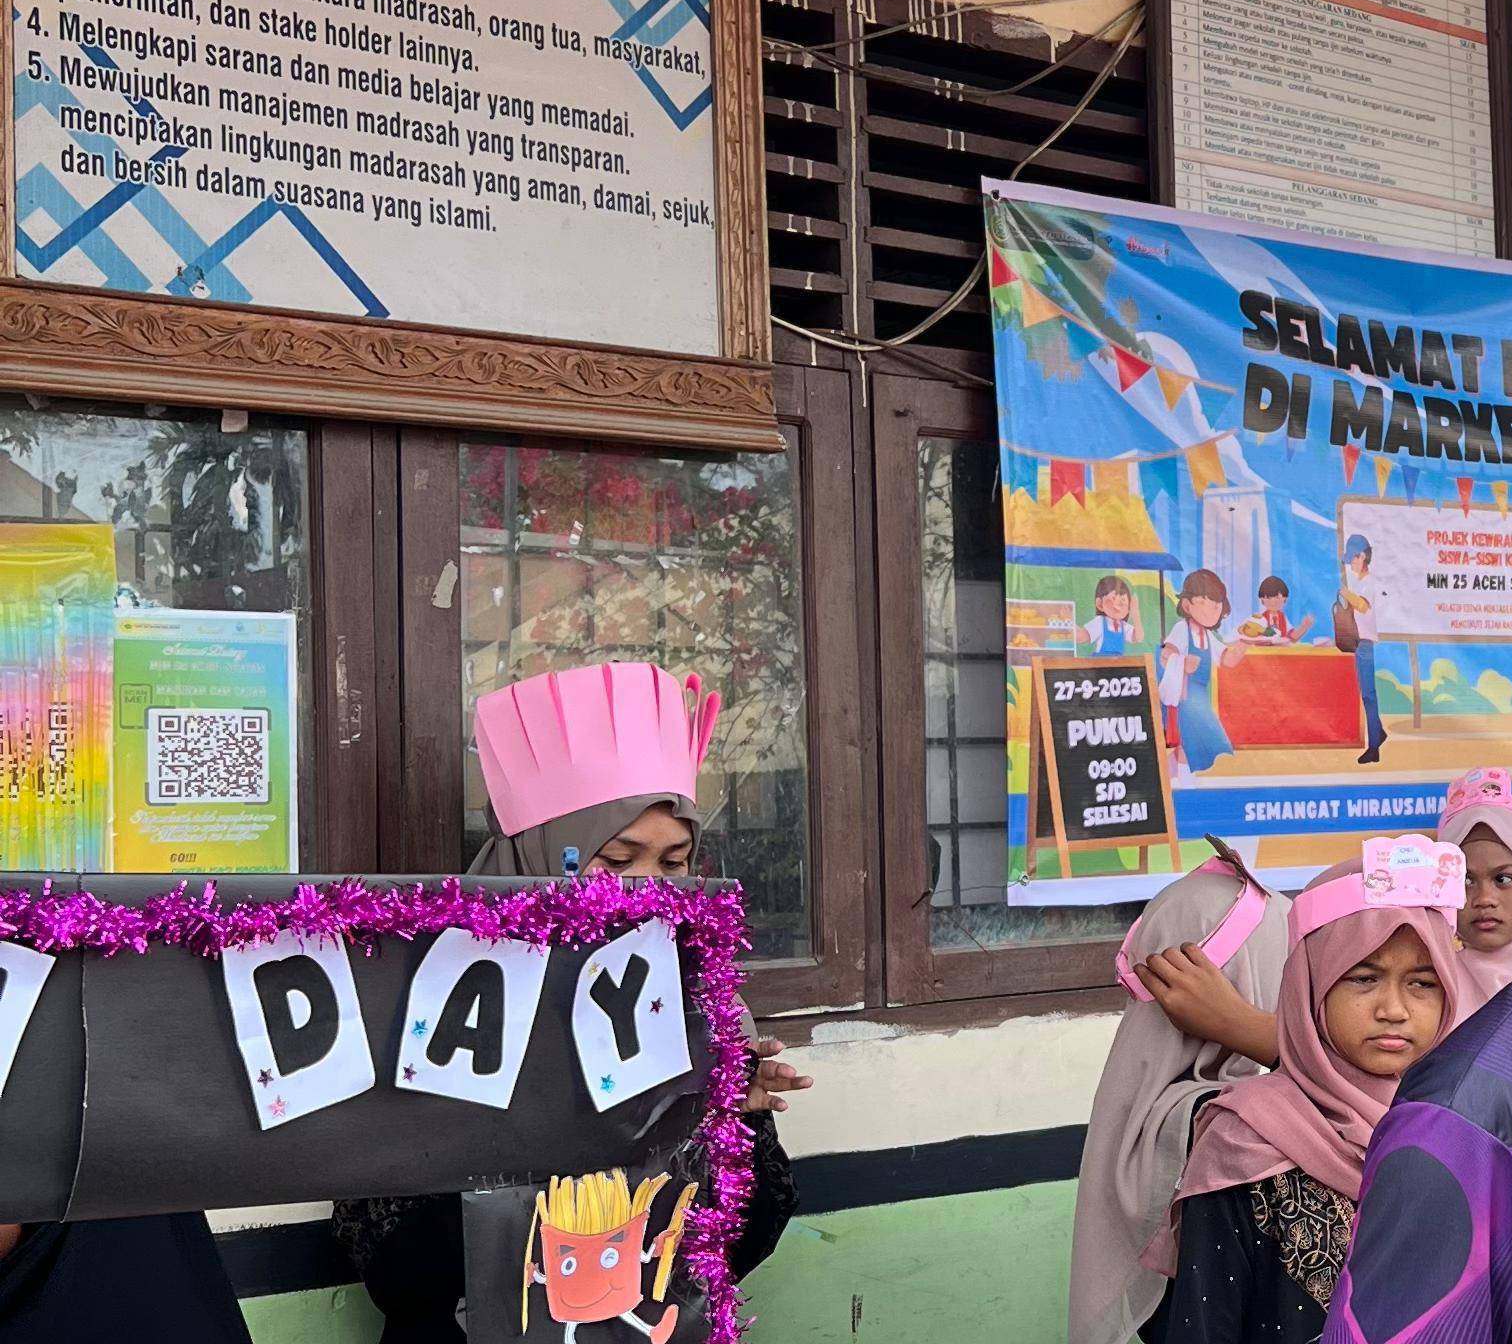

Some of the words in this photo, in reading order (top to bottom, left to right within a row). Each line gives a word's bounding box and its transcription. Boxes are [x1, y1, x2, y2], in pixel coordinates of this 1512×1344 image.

[27, 7, 50, 37] 4.
[59, 12, 197, 67] Melengkapi
[205, 44, 282, 78] sarana
[291, 53, 330, 86] dan
[338, 67, 402, 98] media
[410, 74, 481, 114] belajar
[487, 93, 534, 126] yang
[541, 102, 634, 138] memadai.
[259, 10, 317, 42] stake
[325, 18, 392, 55] holder
[399, 32, 479, 73] lainnya.
[489, 15, 545, 51] orang
[552, 23, 587, 57] tua,
[594, 36, 706, 79] masyarakat,
[27, 52, 51, 81] 5.
[60, 55, 209, 108] Mewujudkan
[219, 87, 348, 130] manajemen
[356, 109, 459, 147] madrasah
[467, 129, 514, 161] yang
[521, 134, 631, 176] transparan.
[60, 105, 212, 150] menciptakan
[221, 124, 341, 172] lingkungan
[350, 150, 466, 189] madarasah
[473, 169, 520, 201] yang
[527, 177, 586, 210] aman,
[593, 184, 656, 219] damai,
[663, 197, 714, 229] sejuk,
[61, 145, 105, 177] dan
[115, 152, 187, 188] bersih
[196, 163, 265, 200] dalam
[273, 179, 364, 213] suasana
[372, 192, 422, 227] yang
[429, 197, 496, 233] islami.
[1238, 288, 1486, 393] SELAMAT
[1241, 362, 1310, 441] DI
[1427, 531, 1468, 545] PROJEK
[1438, 550, 1502, 567] SISWA-SISWI
[1427, 573, 1448, 589] MIN
[1453, 574, 1467, 589] 25
[1473, 575, 1505, 591] ACEH
[1054, 677, 1142, 701] 27-9-2025
[1068, 716, 1147, 747] PUKUL
[1088, 757, 1137, 779] 09:00
[1083, 802, 1148, 827] SELESAI
[1245, 800, 1341, 822] SEMANGAT
[253, 953, 650, 1077] DAY
